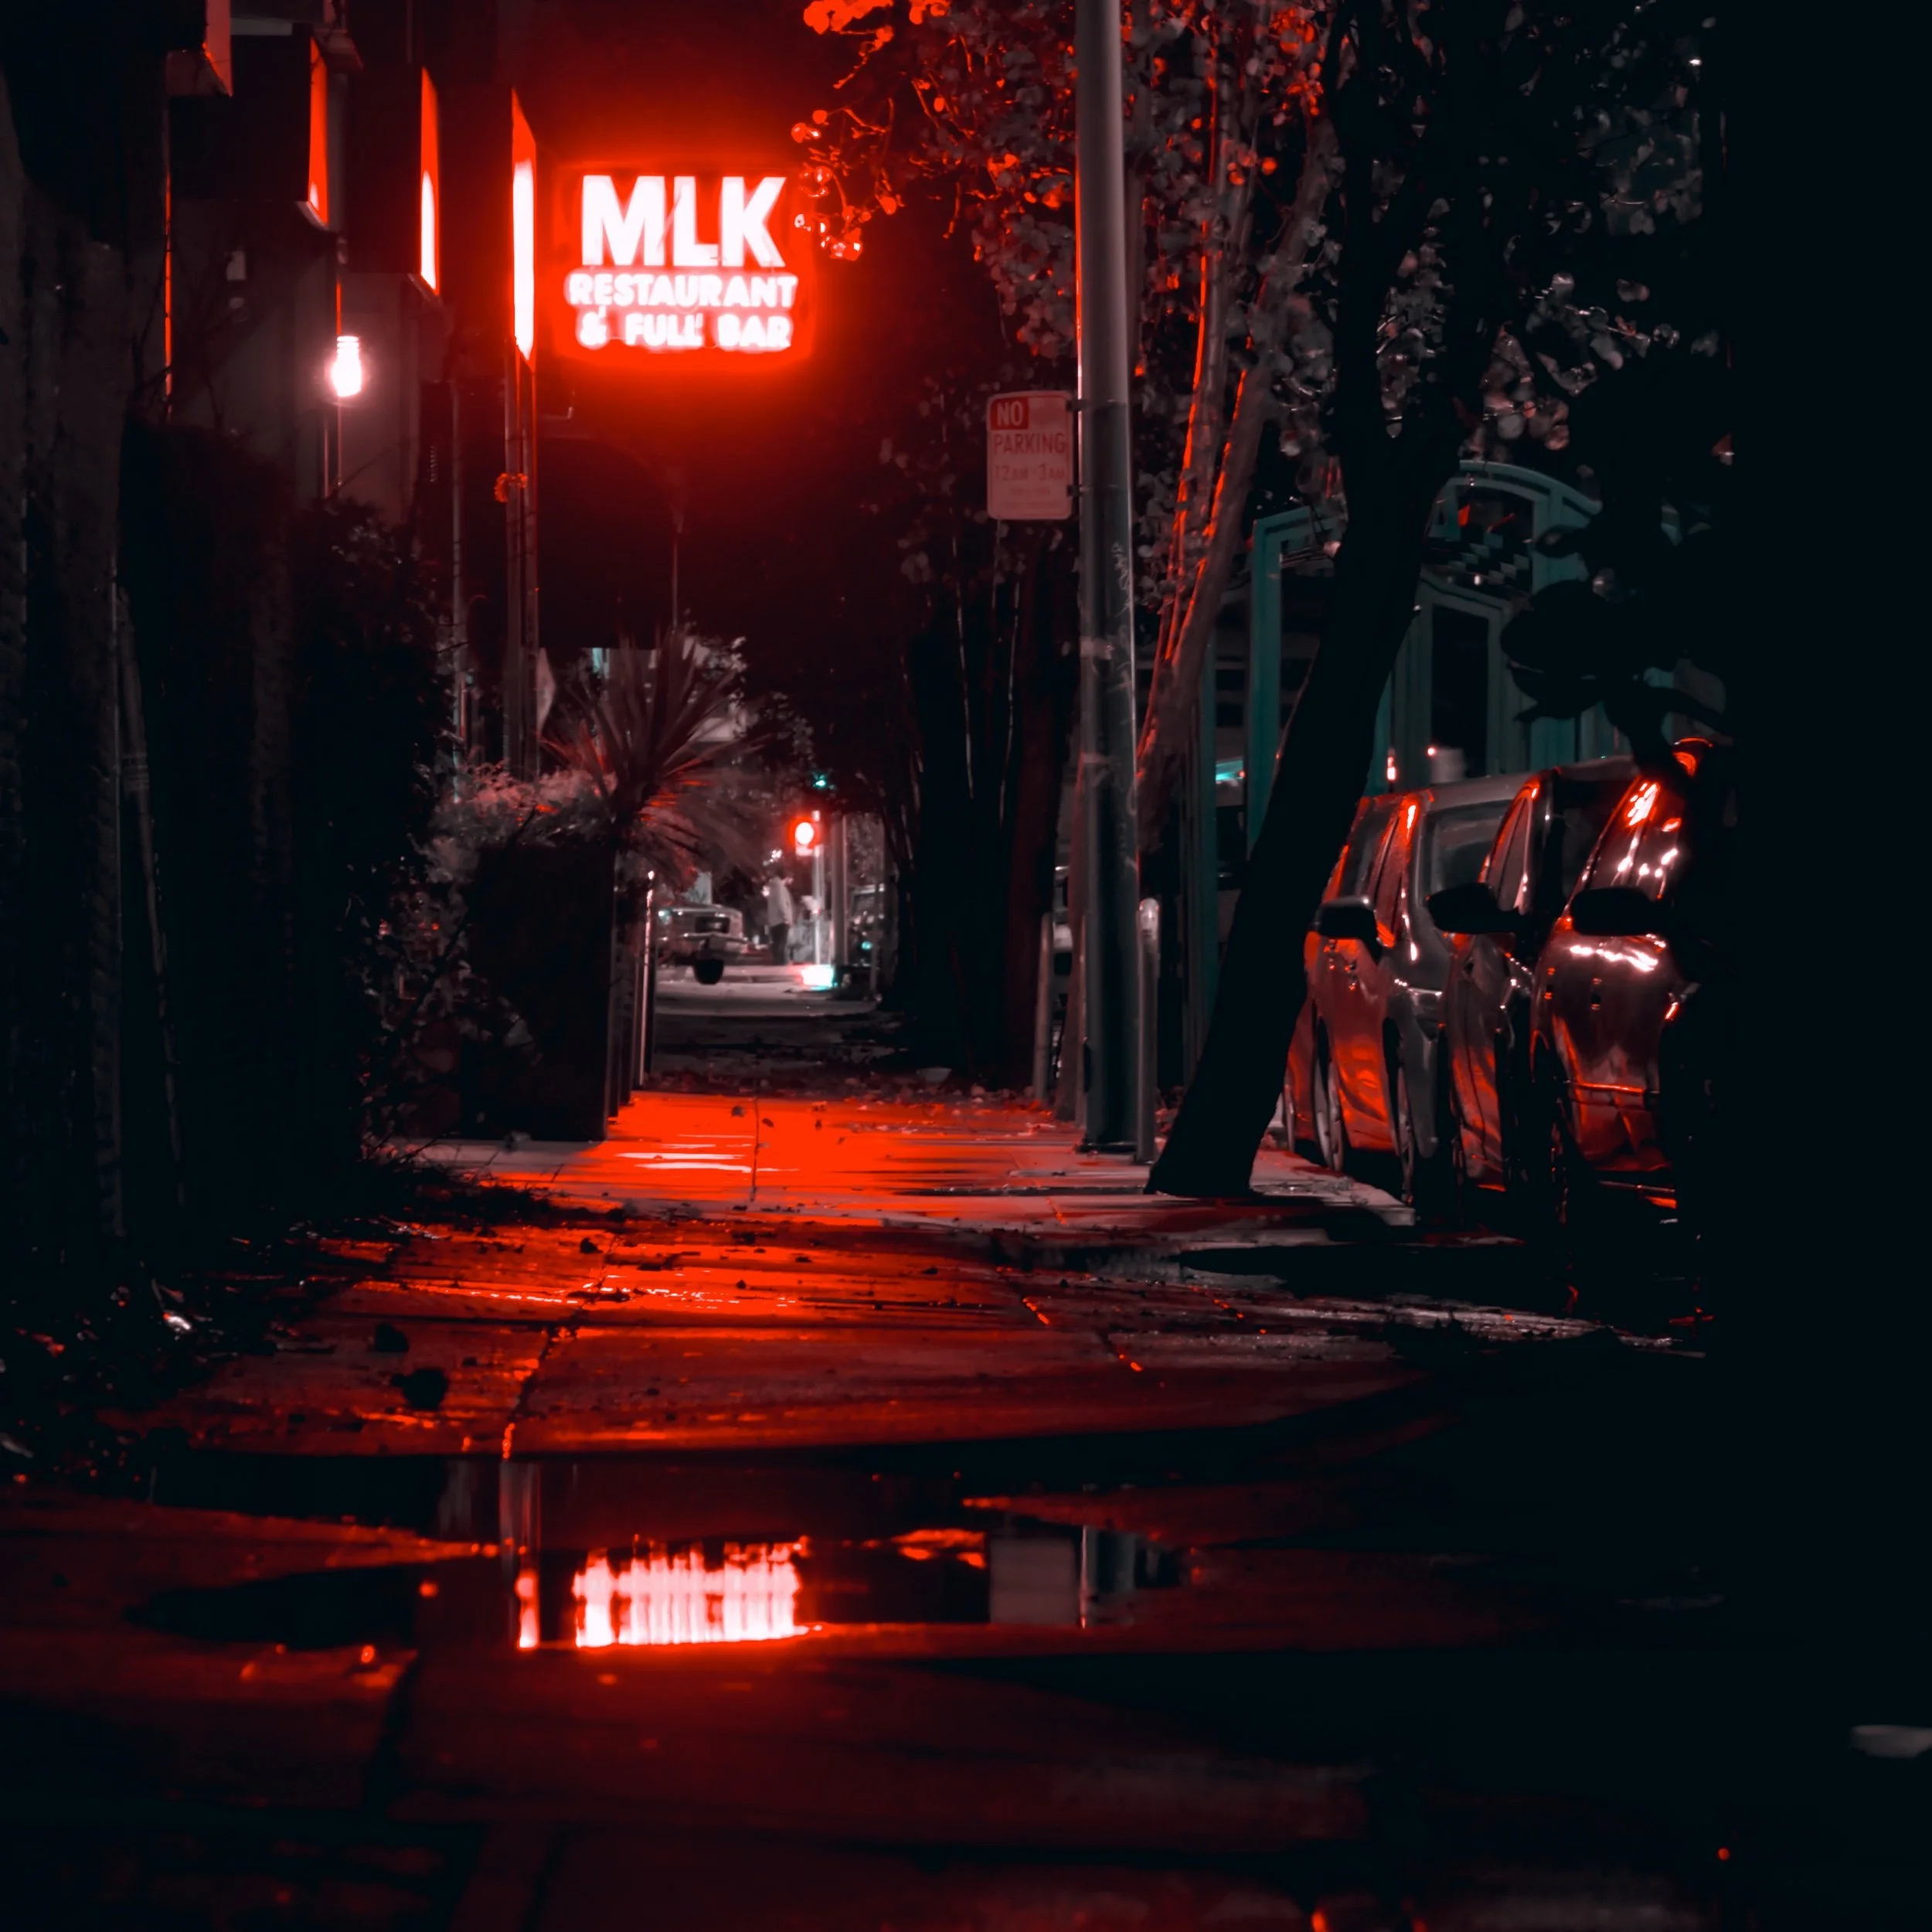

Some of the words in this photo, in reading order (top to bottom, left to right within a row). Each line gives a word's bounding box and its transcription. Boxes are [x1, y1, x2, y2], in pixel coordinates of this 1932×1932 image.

[568, 274, 799, 308] RESTAURANT
[579, 307, 608, 345] &
[624, 313, 703, 347] FULL
[717, 314, 791, 348] BAR
[996, 400, 1024, 427] NO
[994, 433, 1066, 454] PARKING
